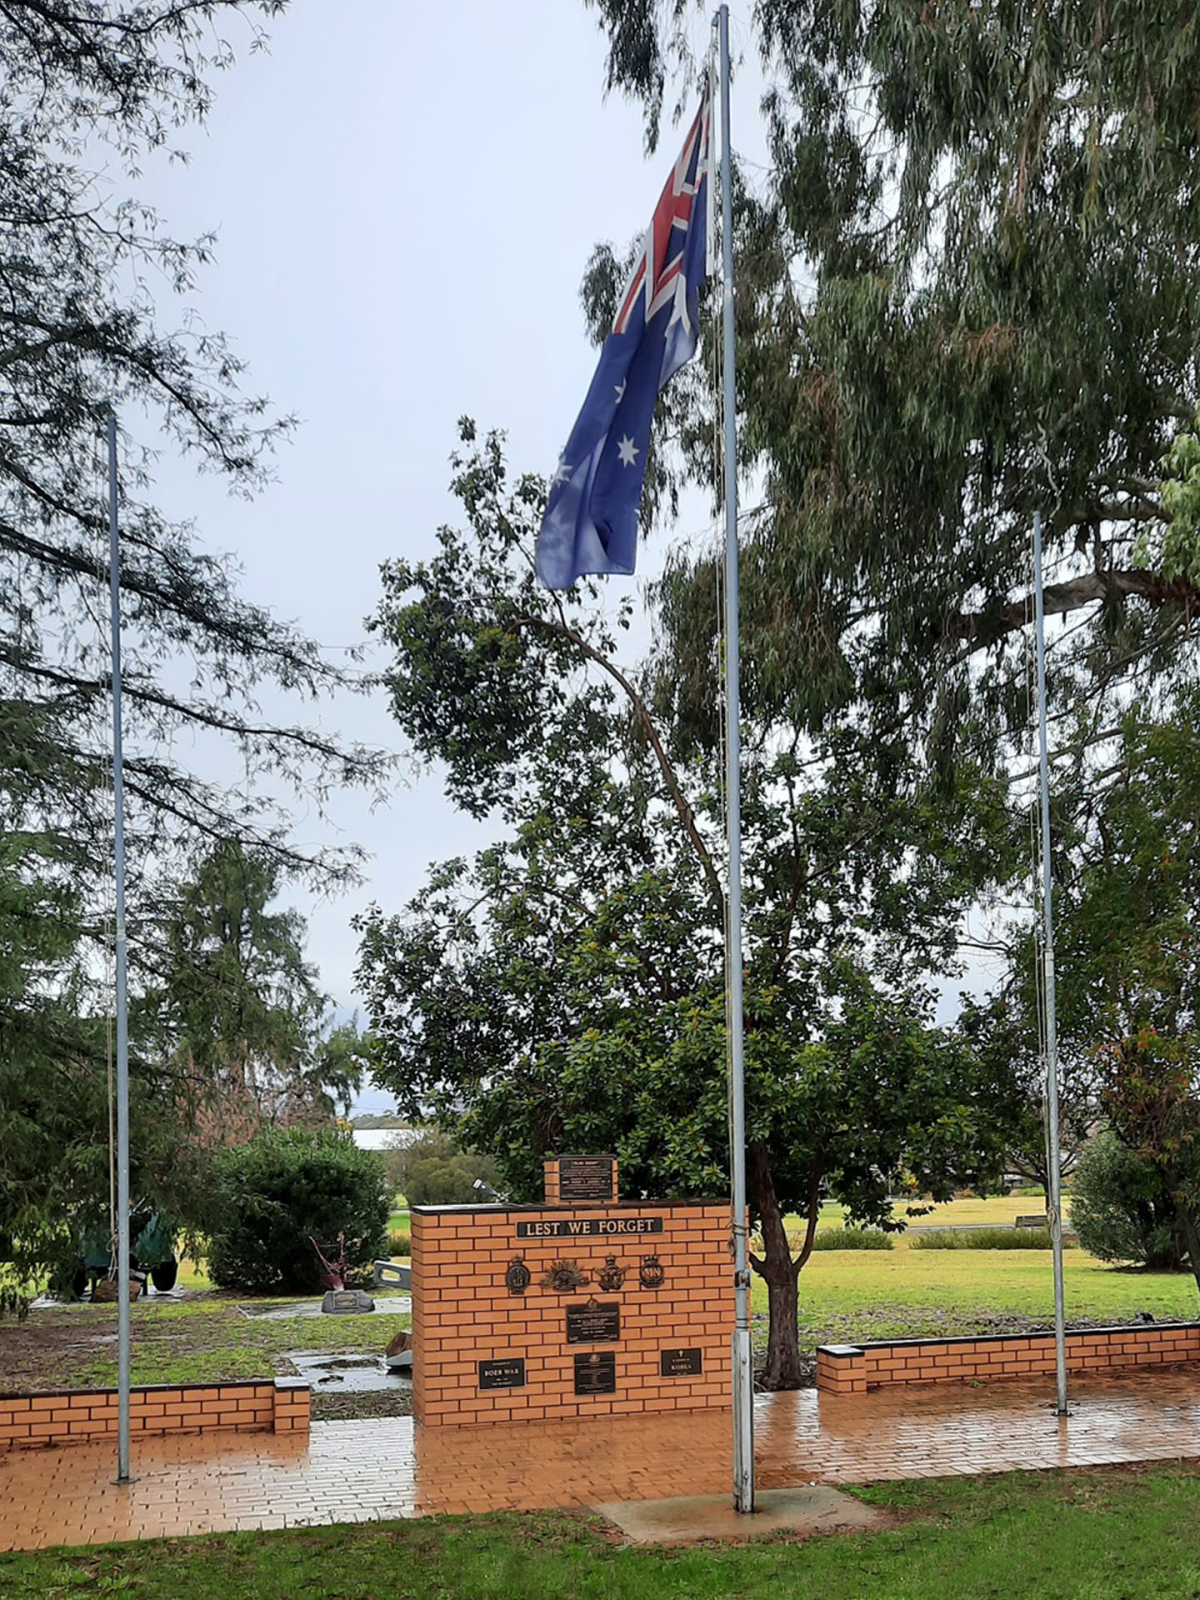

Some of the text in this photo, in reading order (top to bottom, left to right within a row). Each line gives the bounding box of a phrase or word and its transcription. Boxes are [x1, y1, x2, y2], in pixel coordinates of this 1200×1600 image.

[526, 1219, 654, 1236] LEST WE FORGET
